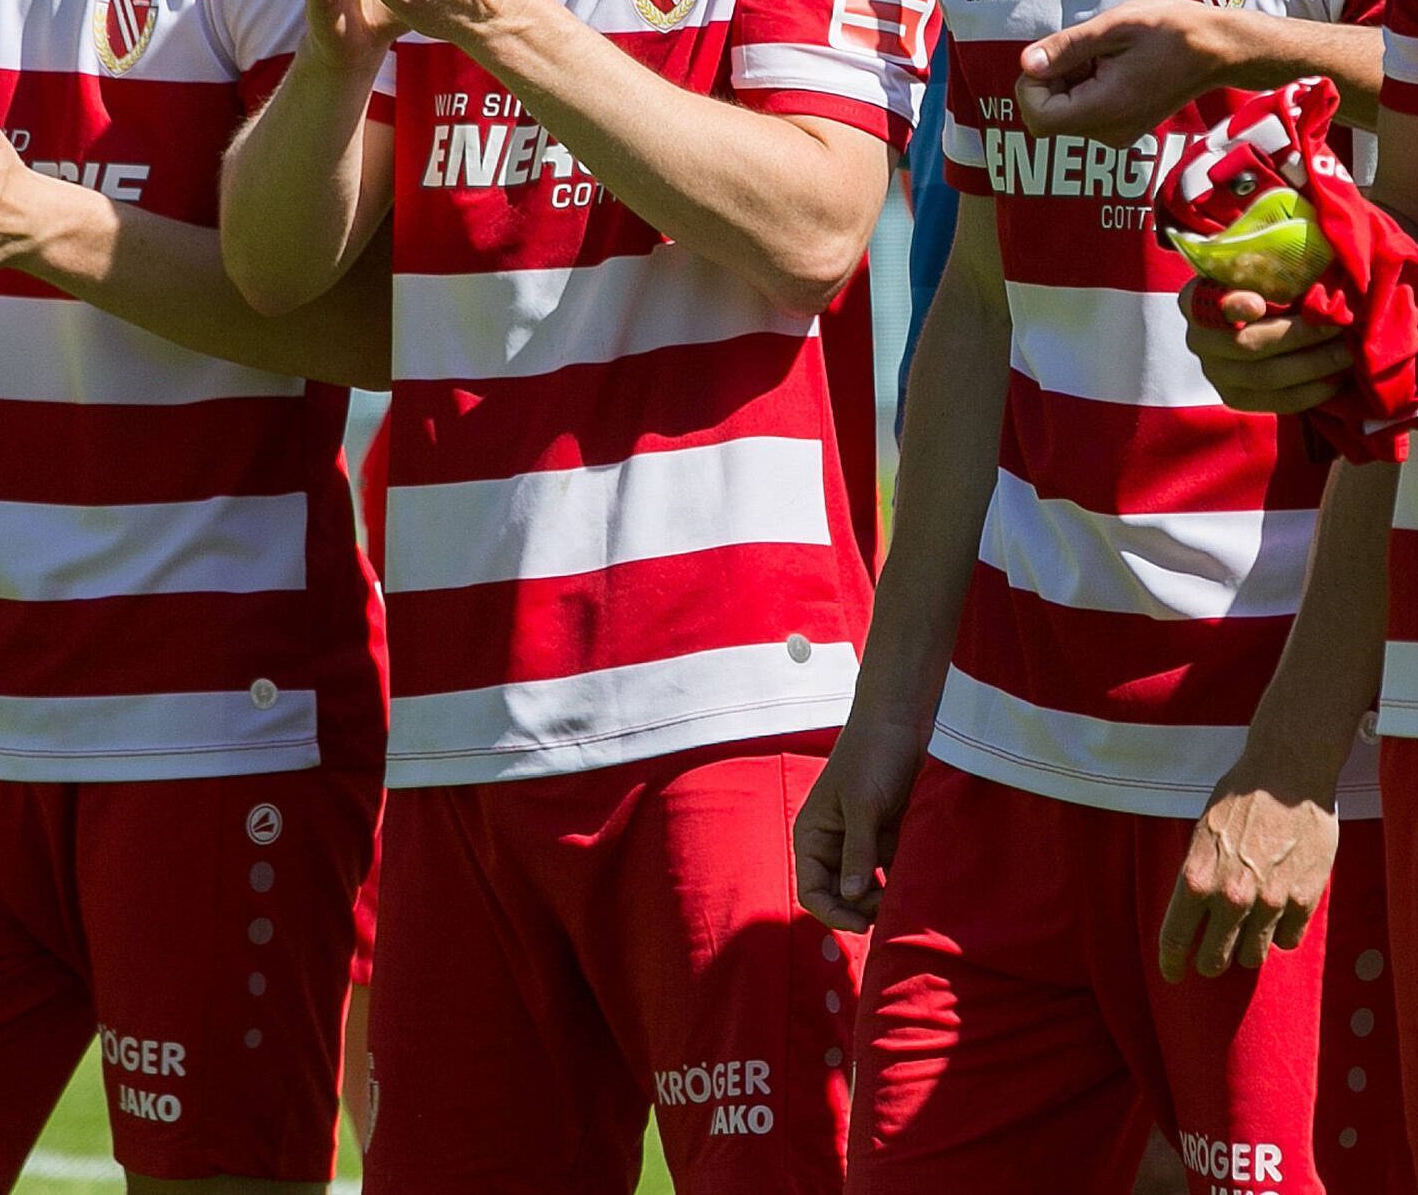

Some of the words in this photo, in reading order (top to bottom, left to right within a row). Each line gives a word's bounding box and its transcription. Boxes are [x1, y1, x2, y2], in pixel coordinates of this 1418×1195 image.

[435, 93, 469, 118] WIR
[421, 123, 593, 188] ENER
[97, 1023, 187, 1077] ÖGER
[654, 1059, 772, 1106] KRÖGER
[1179, 1129, 1283, 1183] KRÖGER
